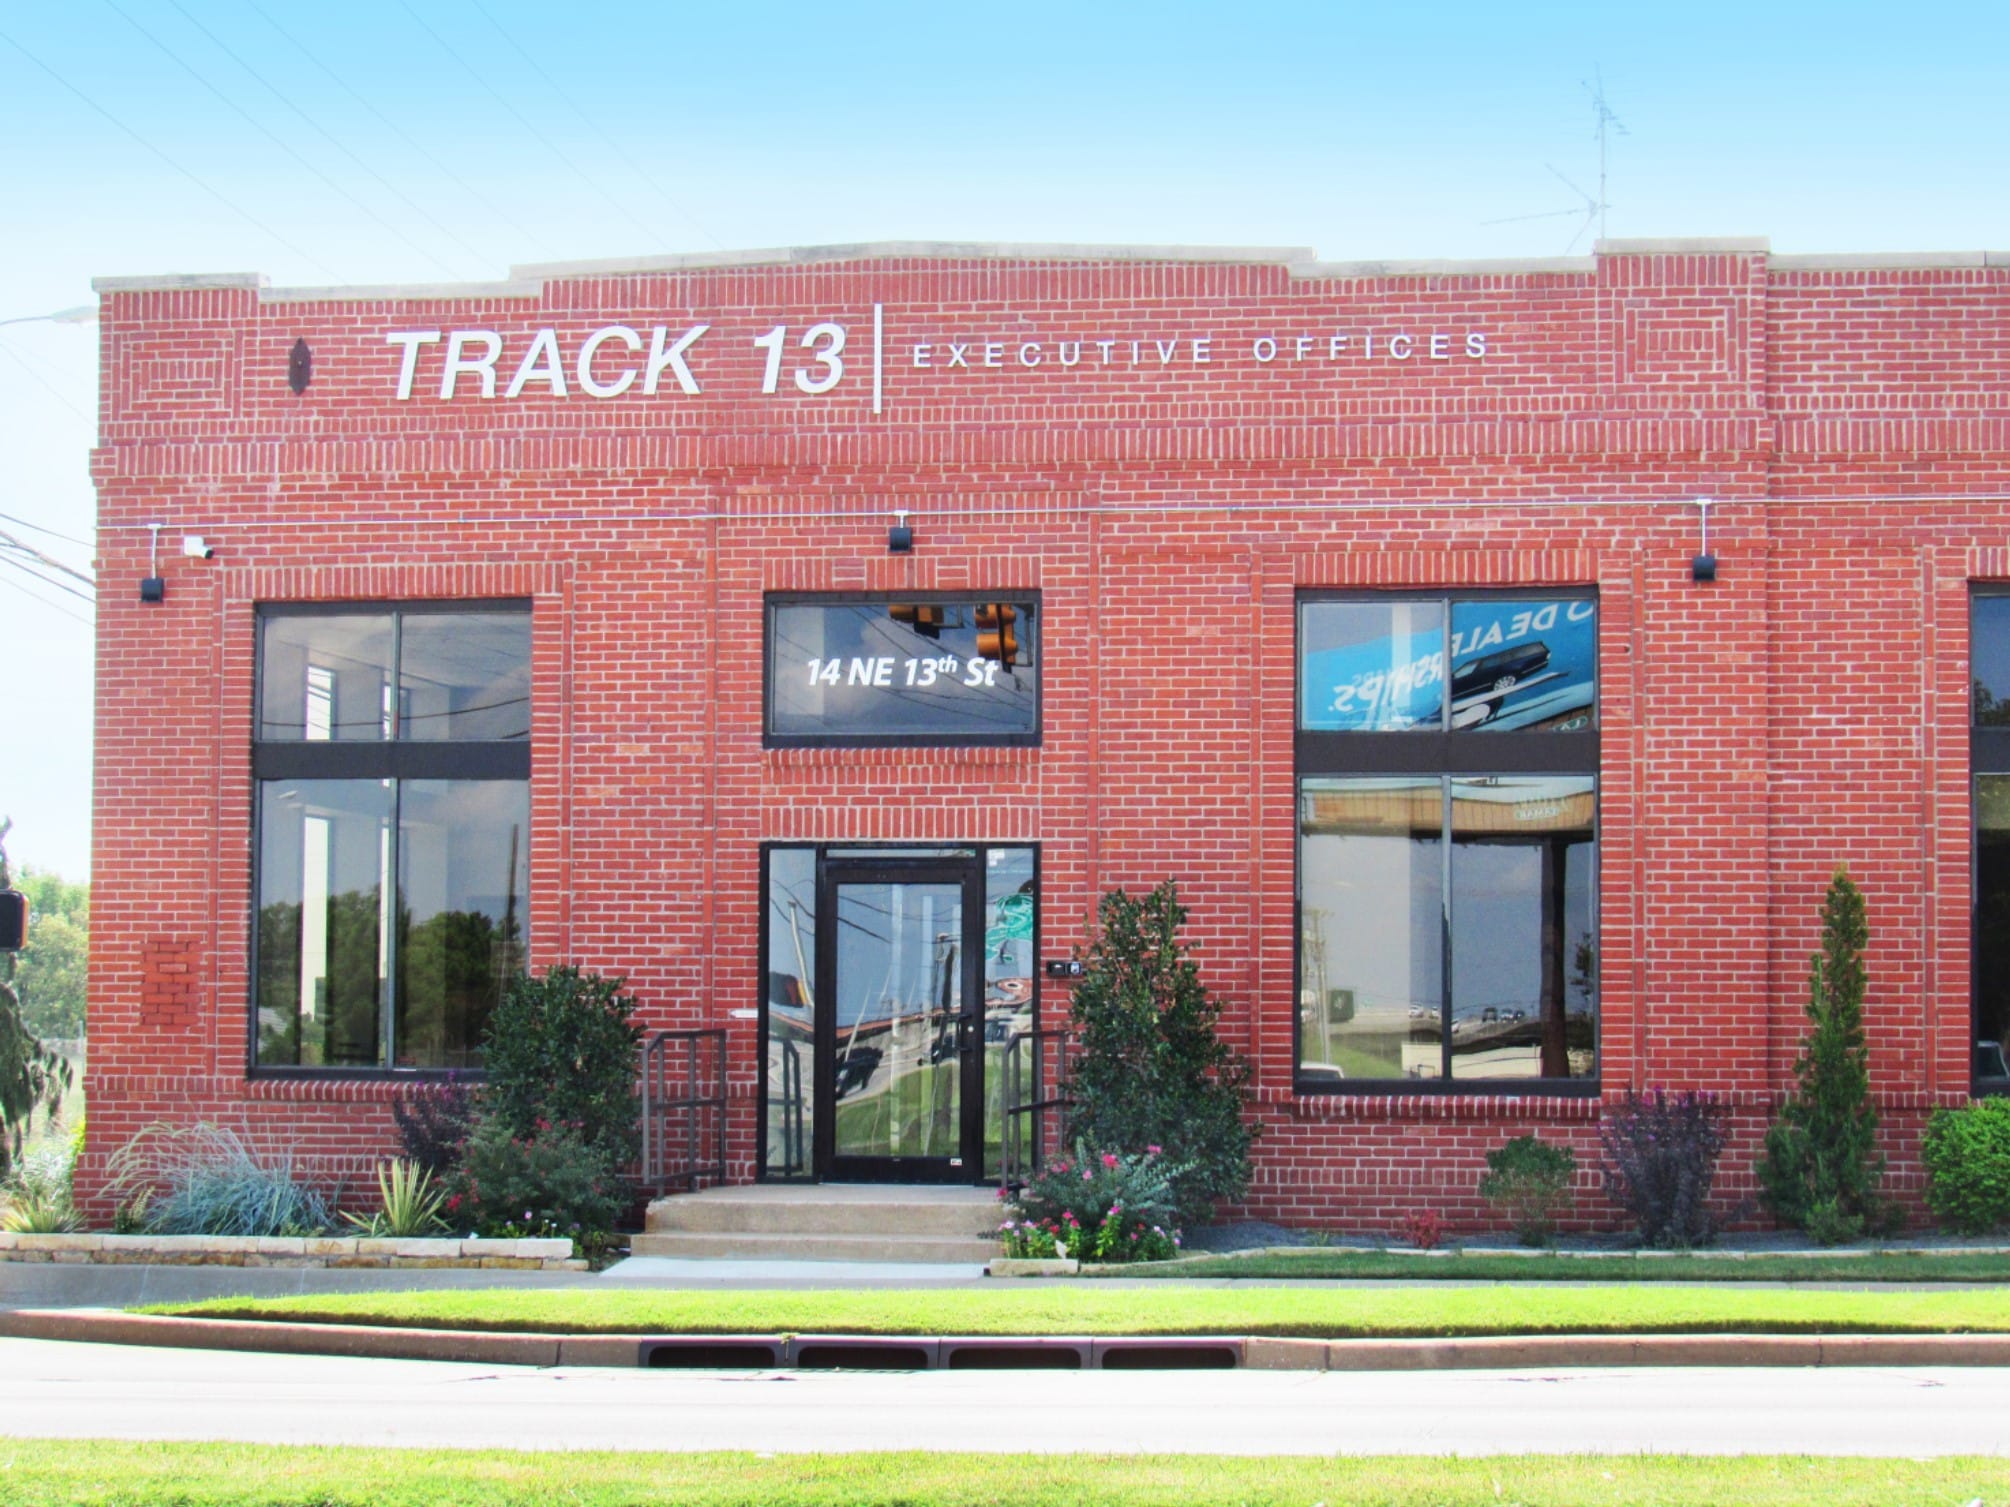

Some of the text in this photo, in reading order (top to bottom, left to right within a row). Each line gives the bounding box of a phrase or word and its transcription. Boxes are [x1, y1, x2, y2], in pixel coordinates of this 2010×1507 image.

[385, 323, 846, 400] TRACK 13
[912, 333, 1487, 369] EXECUTIVE OFFICES
[806, 654, 999, 688] 14 NE 13th St
